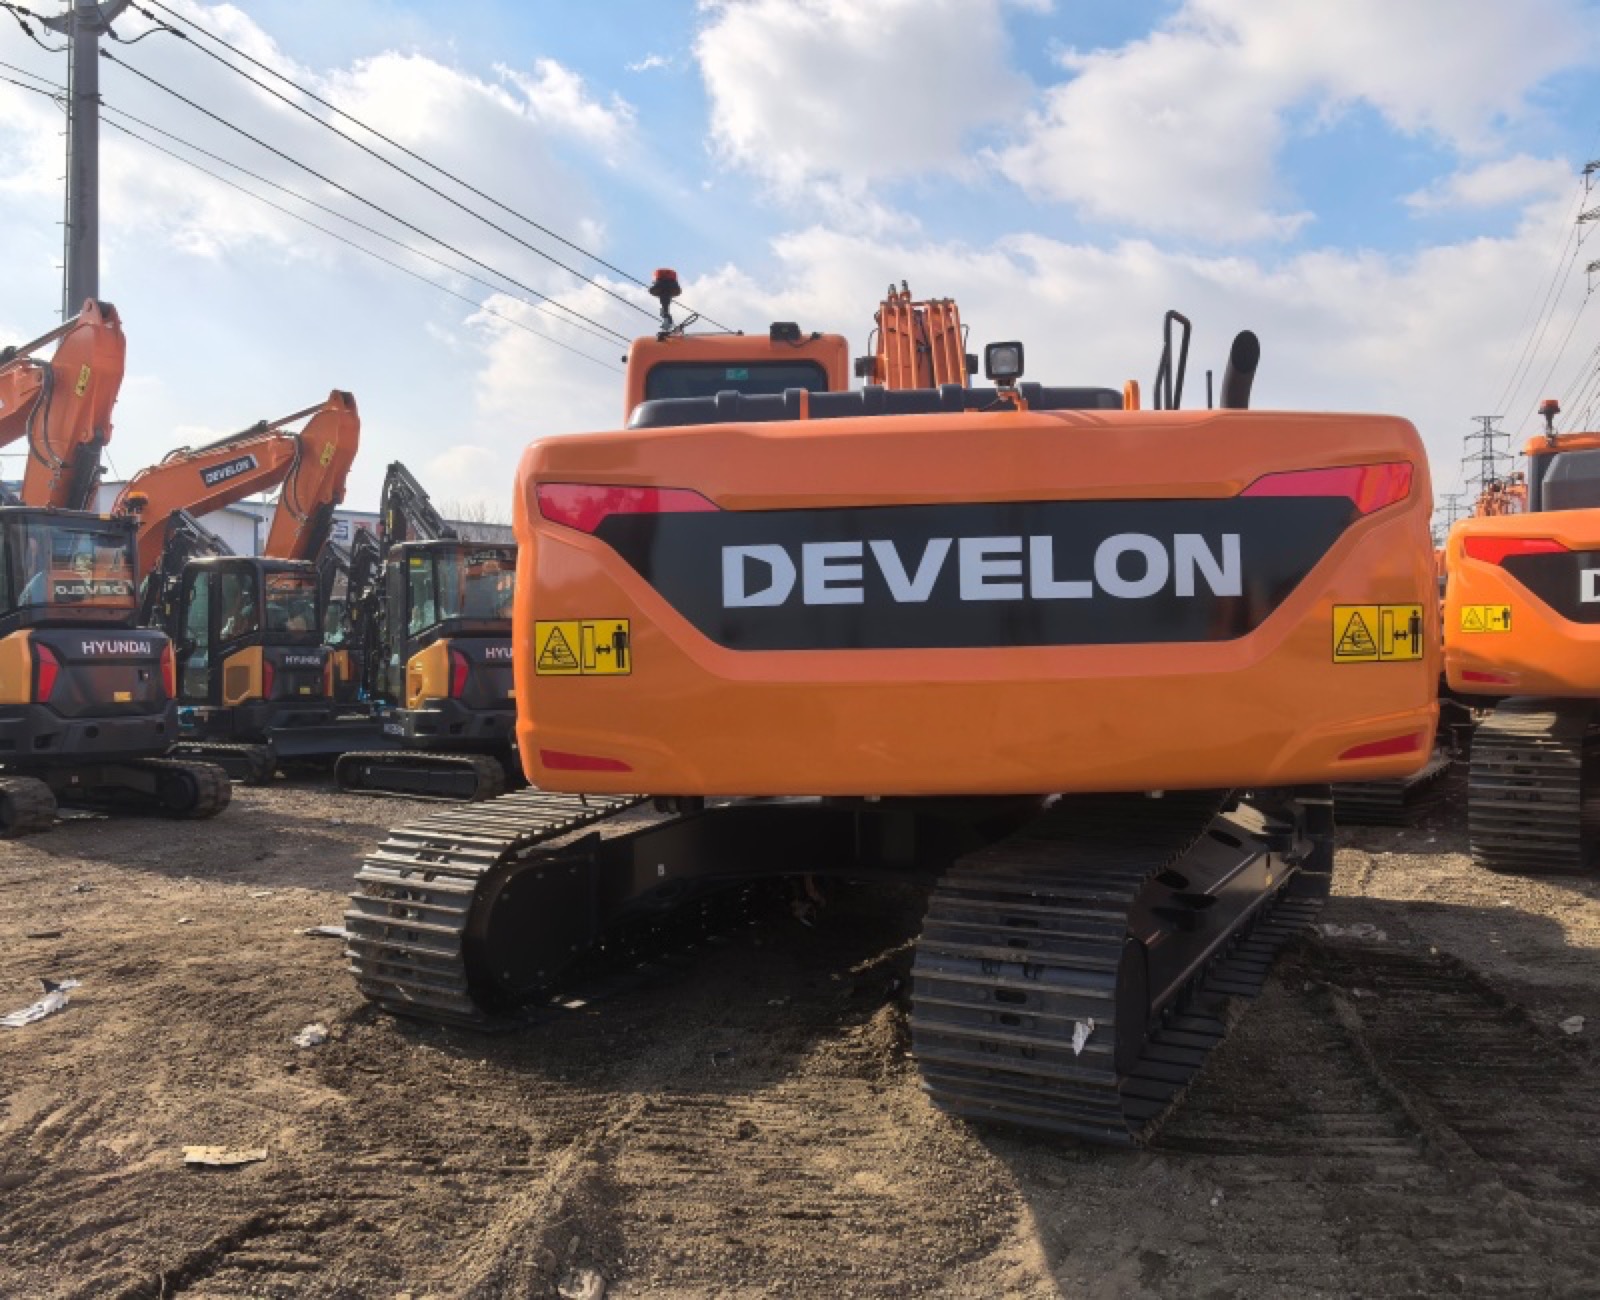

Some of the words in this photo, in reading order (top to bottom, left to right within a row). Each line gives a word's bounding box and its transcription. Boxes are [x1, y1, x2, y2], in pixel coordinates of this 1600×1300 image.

[205, 459, 249, 484] DEVELON
[722, 532, 1242, 607] DEVELON
[82, 641, 151, 655] HYUNDAI
